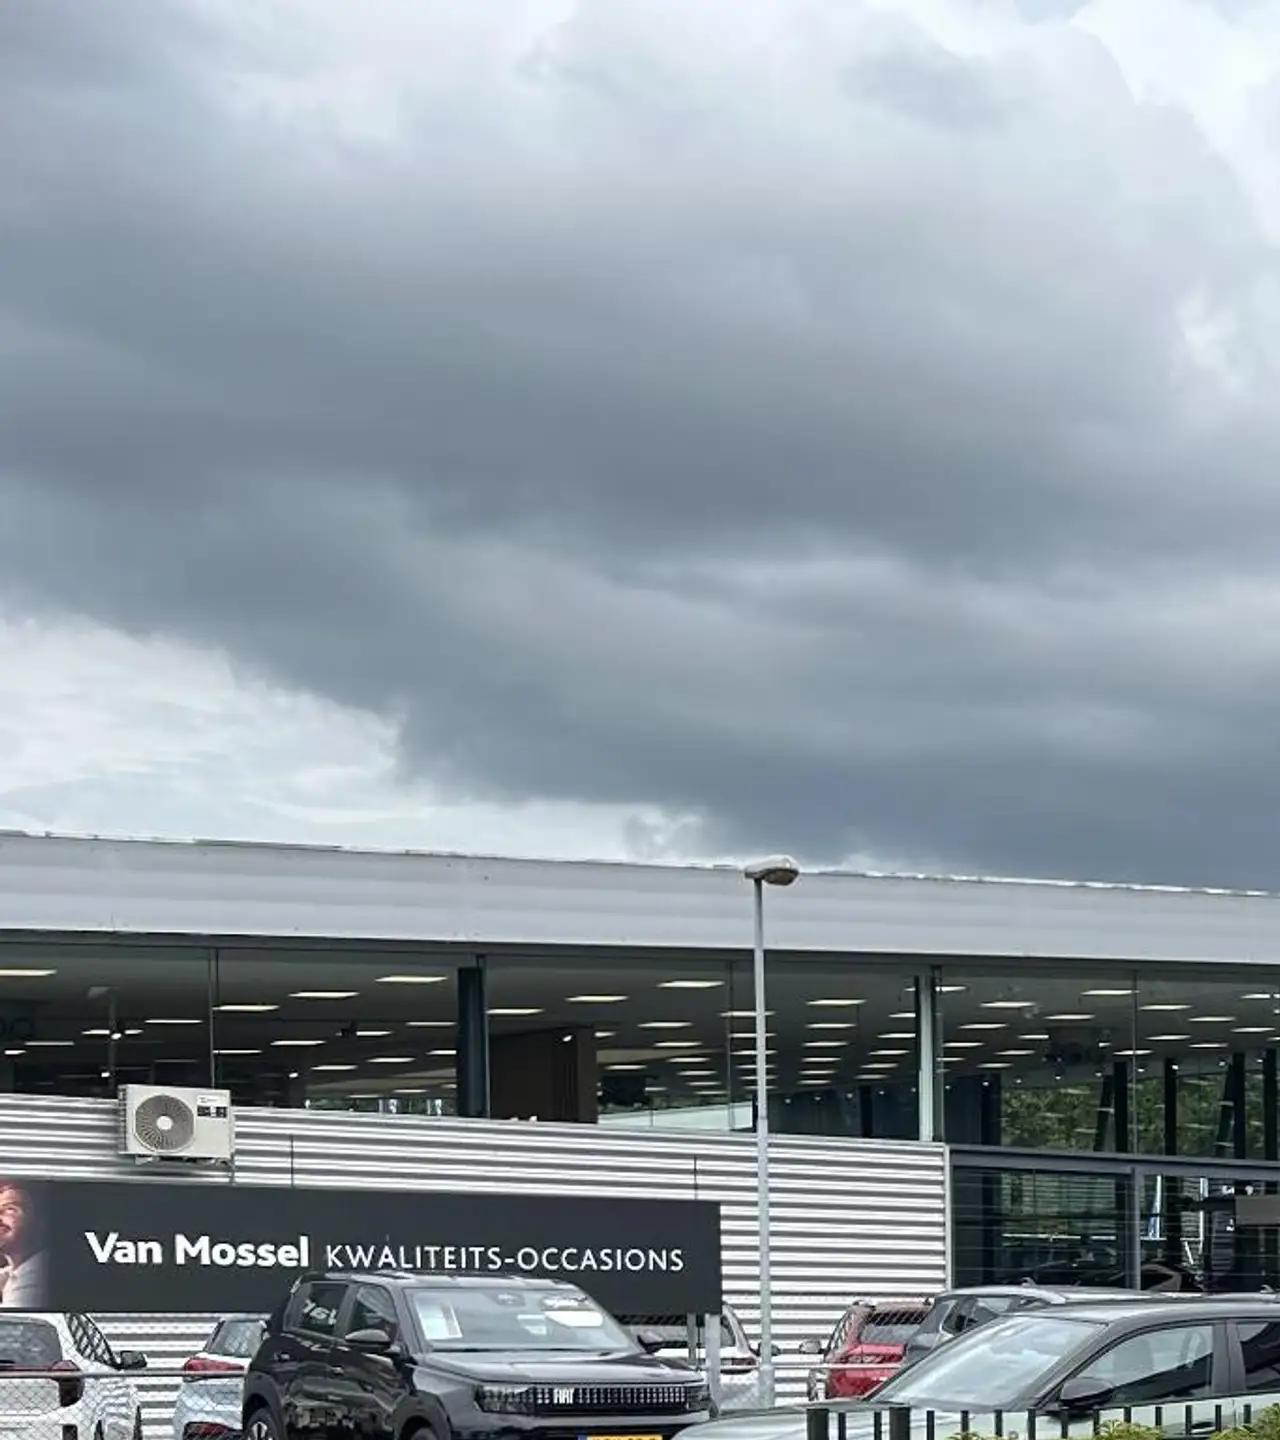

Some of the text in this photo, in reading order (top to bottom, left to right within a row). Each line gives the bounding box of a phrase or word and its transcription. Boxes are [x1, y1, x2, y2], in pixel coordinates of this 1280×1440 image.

[84, 1230, 685, 1272] Van Mossel KWALITEITS-OCCASIONS
